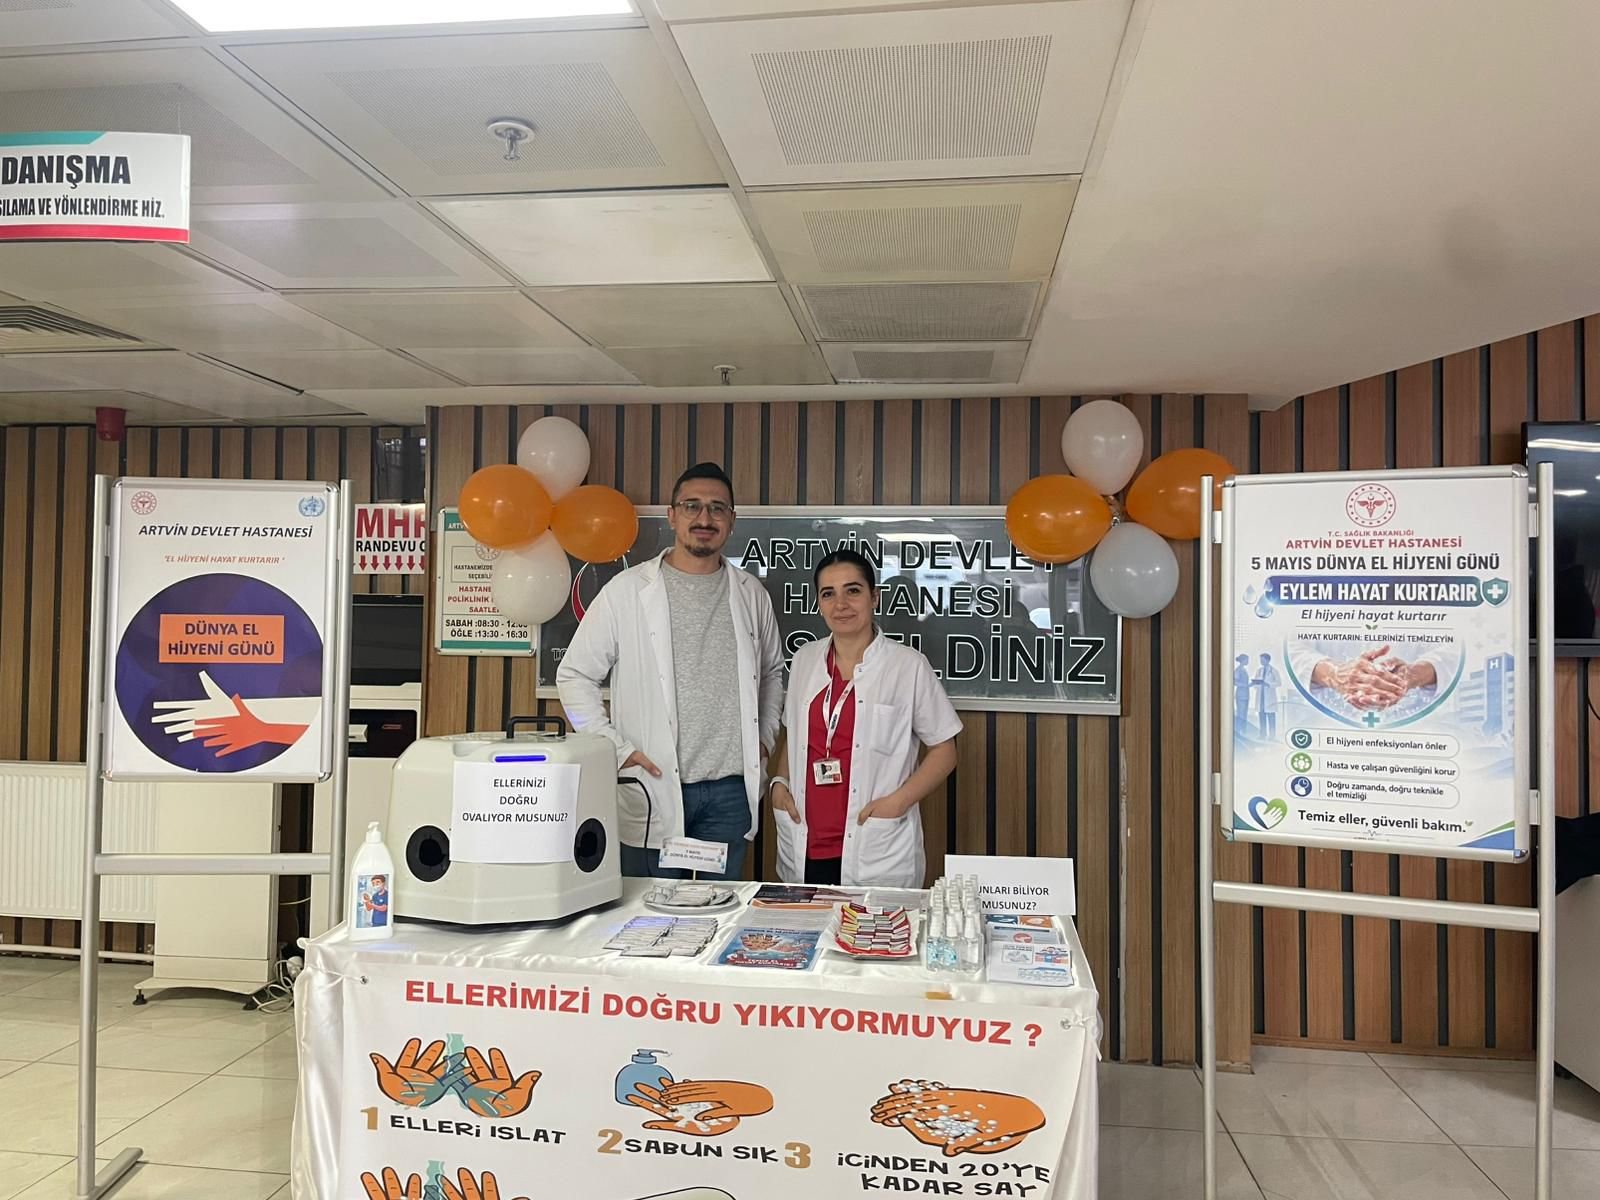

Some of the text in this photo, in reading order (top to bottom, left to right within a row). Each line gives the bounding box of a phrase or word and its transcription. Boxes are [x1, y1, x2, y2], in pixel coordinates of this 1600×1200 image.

[2, 155, 131, 189] DANIŞMA
[38, 198, 52, 215] VE
[54, 195, 138, 217] YÖNLENDİRME
[142, 197, 165, 218] HİZ.
[138, 523, 313, 538] ARTVİN DEVLET HASTANESİ
[1373, 529, 1414, 537] BAKANLIĞI
[356, 540, 416, 552] RANDEVU
[1286, 535, 1462, 549] ARTVİN DEVLET HASTANESİ
[210, 555, 236, 563] HAYAT
[238, 556, 280, 564] KURTARIR
[1251, 553, 1500, 570] 5 MAYIS DÜNYA EL HİJYENİ GÜNÜ
[784, 578, 1013, 618] HTANESİ
[1279, 582, 1477, 602] EYLEM HAYAT KURTARIR
[1301, 609, 1447, 622] El hijyeni hayat kurtarır
[185, 621, 259, 636] DÜNYA EL
[445, 619, 473, 627] SABAH
[506, 630, 528, 638] 16:30
[1297, 633, 1321, 641] HAYAT
[1364, 633, 1405, 642] ELLERİNİZİ
[1407, 634, 1454, 643] TEMİZLEYİN
[168, 641, 275, 656] HİJYENİ GÜNÜ
[1490, 659, 1499, 669] H
[1326, 736, 1334, 744] El
[1336, 737, 1364, 747] hijyeni
[1425, 741, 1447, 750] önler
[1326, 761, 1348, 769] Hasta
[1361, 763, 1387, 773] çalışan
[1389, 764, 1432, 775] güvenliğini
[1434, 766, 1456, 775] korur
[493, 777, 546, 788] ELLERİNİZİ
[1326, 780, 1350, 790] Doğru
[1388, 785, 1411, 794] doğru
[1413, 786, 1444, 795] teknikle
[499, 794, 538, 805] DOĞRU
[1335, 791, 1367, 801] temizliği
[462, 812, 568, 823] OVALIYOR MUSUNUZ?
[1298, 809, 1466, 833] Temiz eller, güvenli bakım.
[1013, 885, 1049, 896] BİLİYOR
[982, 900, 1037, 911] MUSUNUZ?
[405, 980, 1042, 1047] ELLERİMİZİ DOĞRU YIKIYORMUYUZ ?
[360, 1107, 379, 1130] 1
[490, 1126, 566, 1144] ISLAT
[597, 1129, 778, 1163] 2 SABUN SIK
[784, 1142, 811, 1169] 3
[861, 1173, 1037, 1198] KADAR SAY
